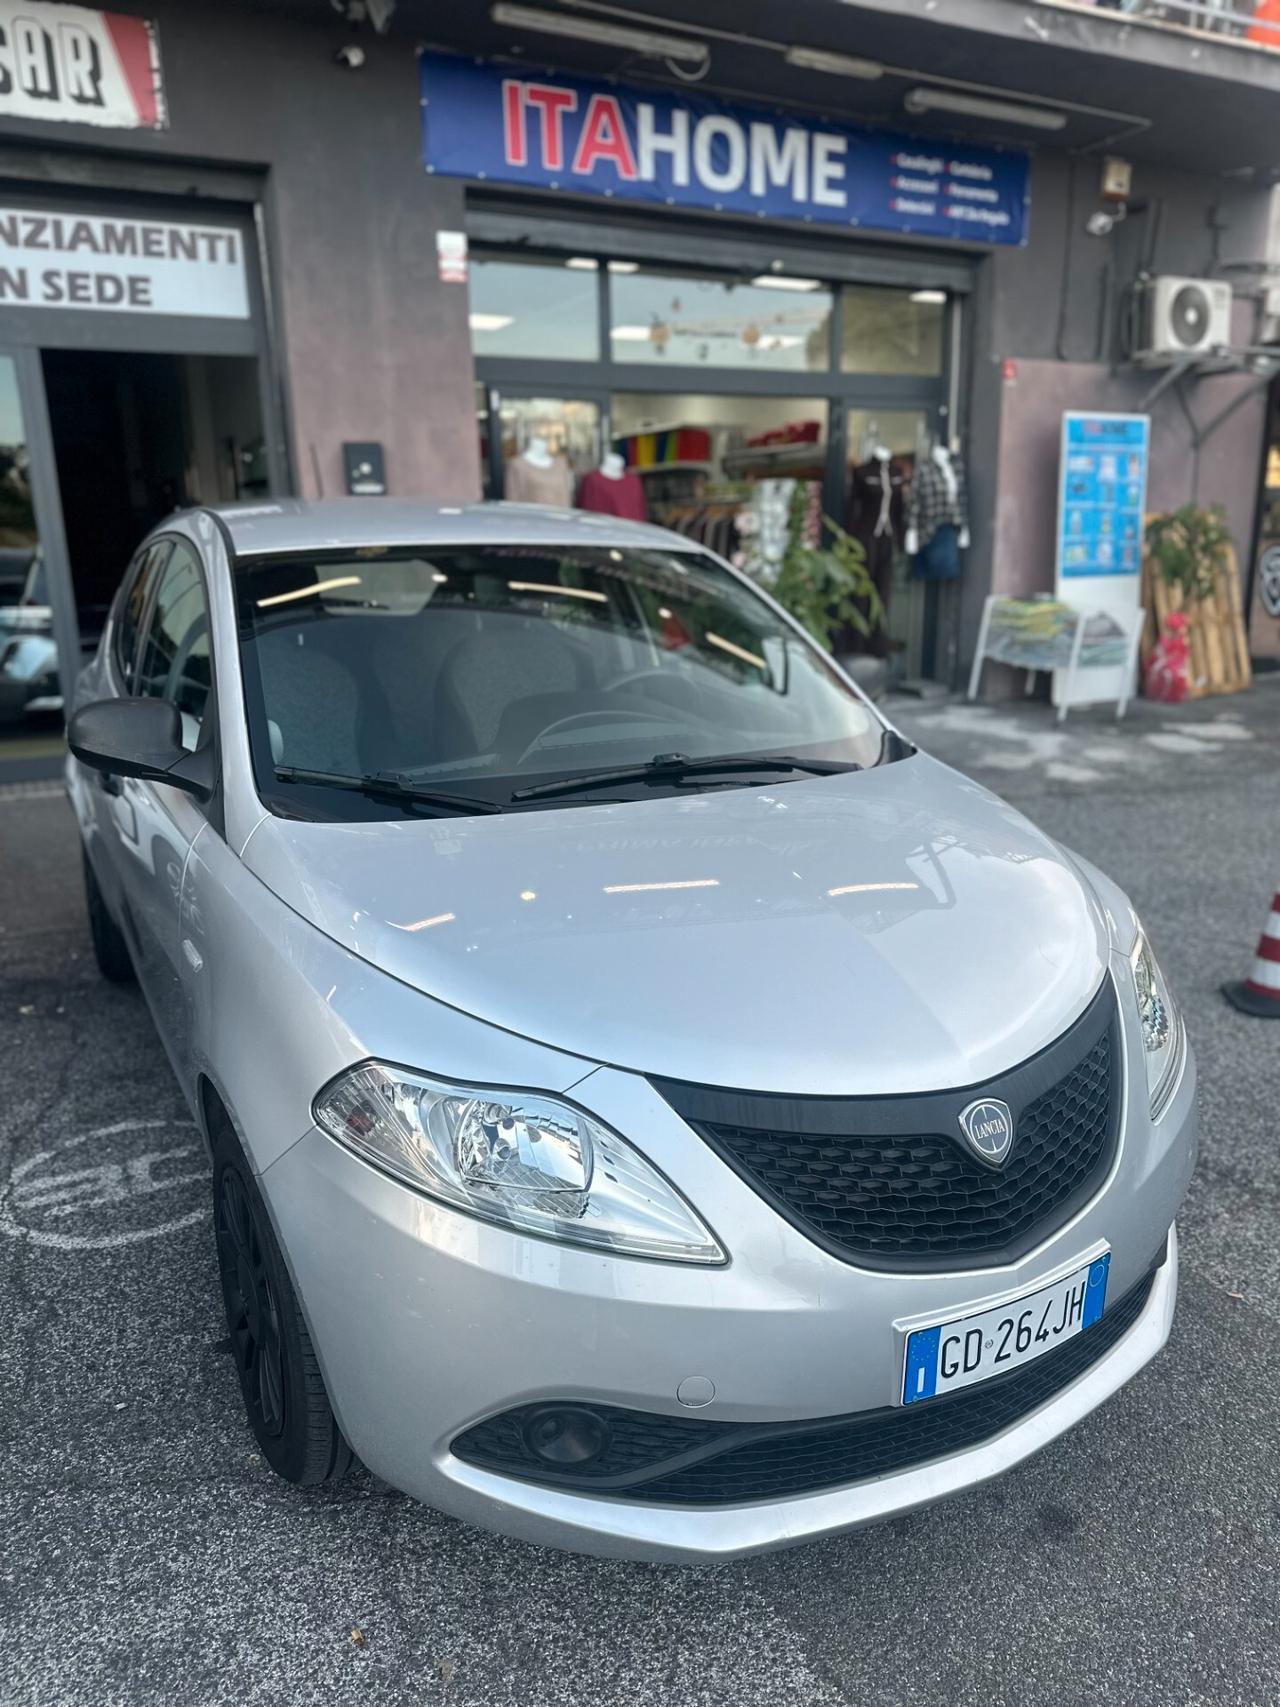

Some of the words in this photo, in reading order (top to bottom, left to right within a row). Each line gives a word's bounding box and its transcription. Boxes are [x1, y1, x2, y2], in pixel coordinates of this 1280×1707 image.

[502, 79, 849, 207] ITAHOME
[42, 269, 153, 306] SEDE
[974, 1118, 1006, 1140] LANCIA
